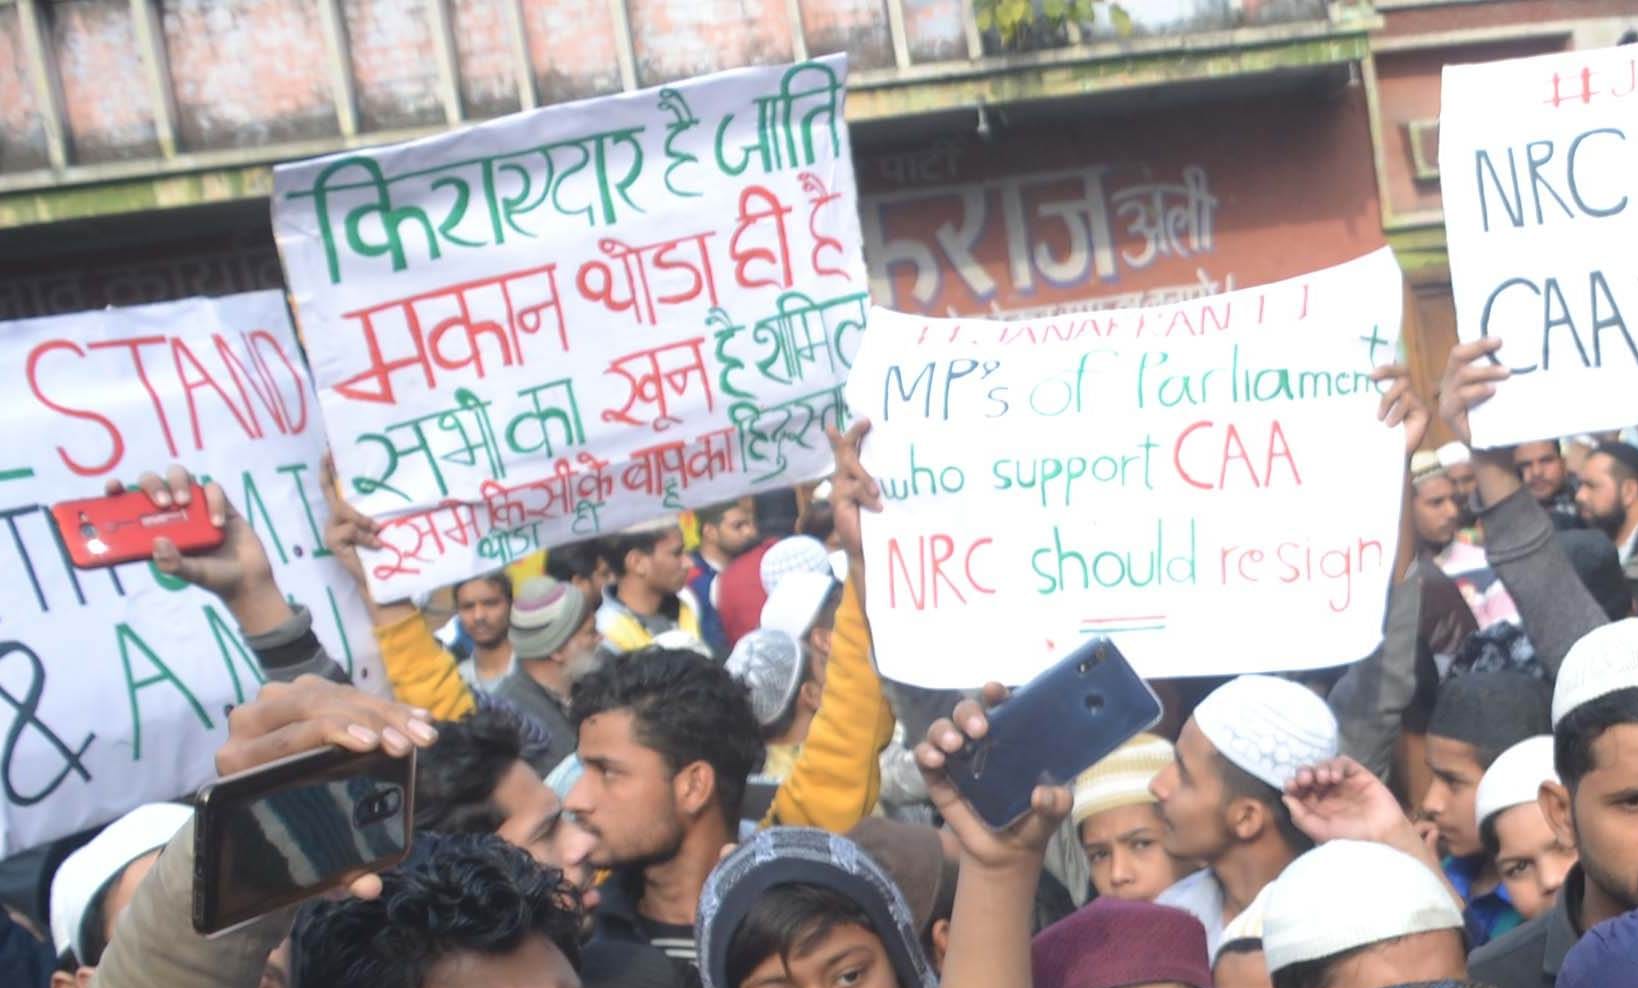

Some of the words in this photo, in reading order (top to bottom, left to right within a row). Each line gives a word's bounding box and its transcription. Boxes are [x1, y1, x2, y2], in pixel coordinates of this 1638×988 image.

[656, 87, 703, 197] है
[1474, 127, 1628, 232] NRC
[331, 263, 571, 405] मकान
[729, 184, 793, 290] ही
[796, 171, 853, 281] है
[25, 329, 308, 478] STAND
[352, 387, 507, 502] सभी
[505, 379, 587, 458] का
[601, 337, 711, 432] खून
[1029, 351, 1119, 415] of
[880, 444, 965, 501] who
[993, 436, 1159, 506] support
[1173, 420, 1302, 490] CAA
[888, 533, 996, 611] NRC
[1031, 518, 1196, 594] should
[1220, 540, 1382, 612] resign
